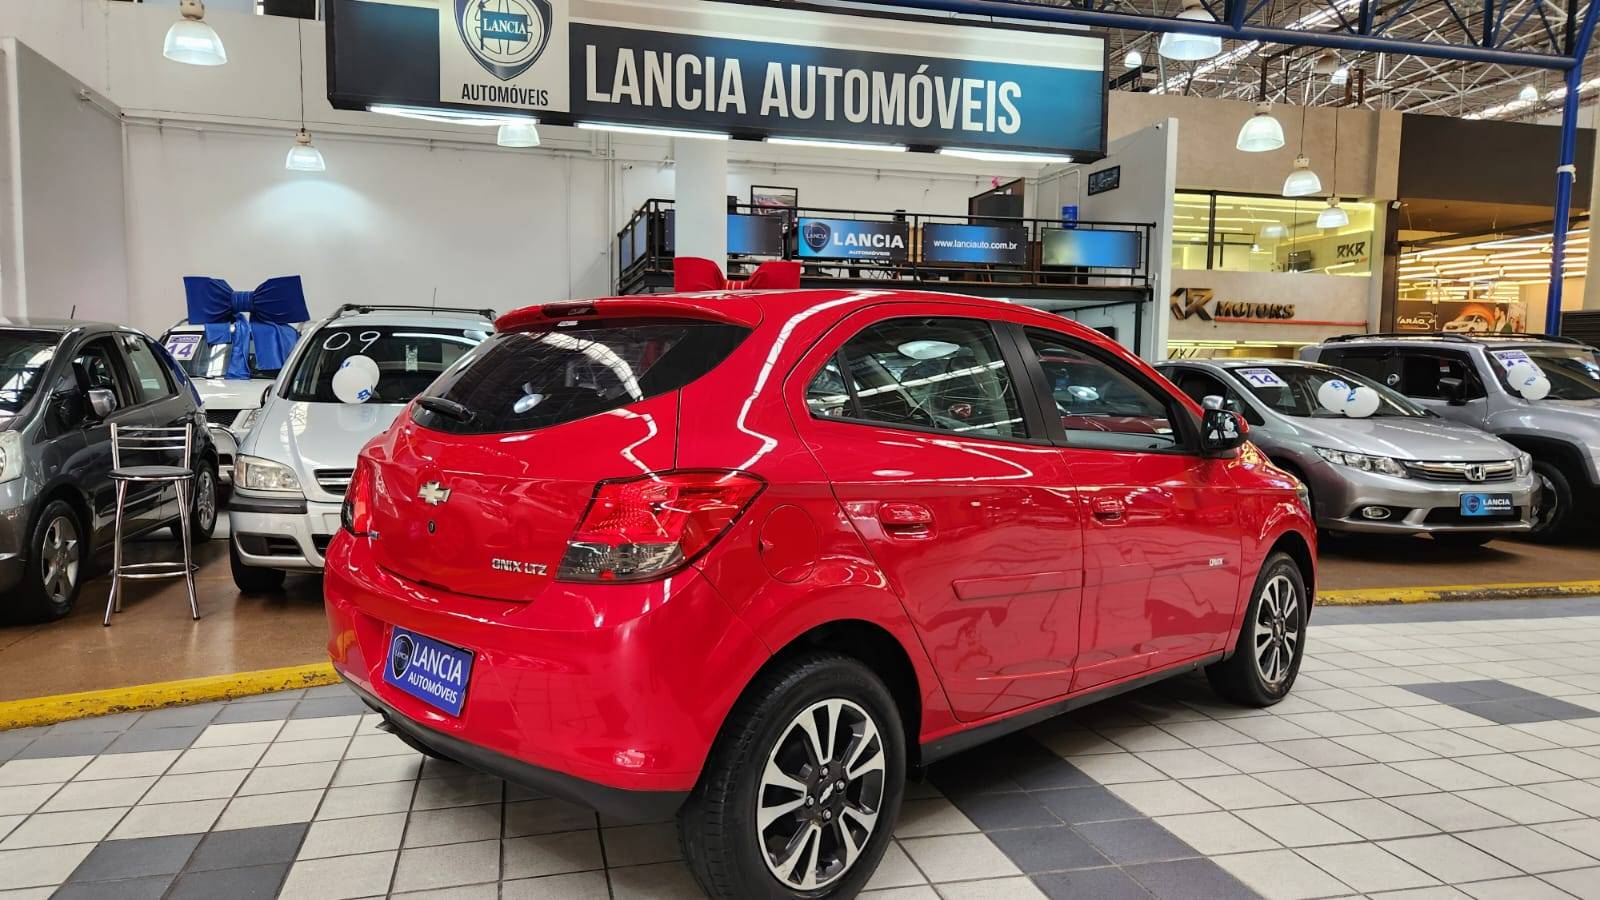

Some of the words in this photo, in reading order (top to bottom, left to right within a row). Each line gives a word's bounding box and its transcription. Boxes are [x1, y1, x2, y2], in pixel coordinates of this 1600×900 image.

[483, 18, 528, 34] LANCIA
[461, 83, 549, 106] AUTOMÓVEIS
[585, 44, 747, 115] LANCIA
[760, 62, 1022, 135] AUTOMÓVEIS
[833, 232, 905, 249] LANCIA
[933, 239, 1018, 250] www.lanciauto.com.br
[1214, 300, 1296, 319] MOTORS
[167, 343, 194, 358] 14
[322, 330, 381, 353] 09
[1250, 374, 1279, 385] 14
[1482, 498, 1510, 506] LANCIA
[492, 558, 522, 573] ONIX
[524, 562, 548, 576] LTZ
[412, 642, 463, 686] LANCIA
[407, 671, 458, 705] AUTOMÓVEIS
